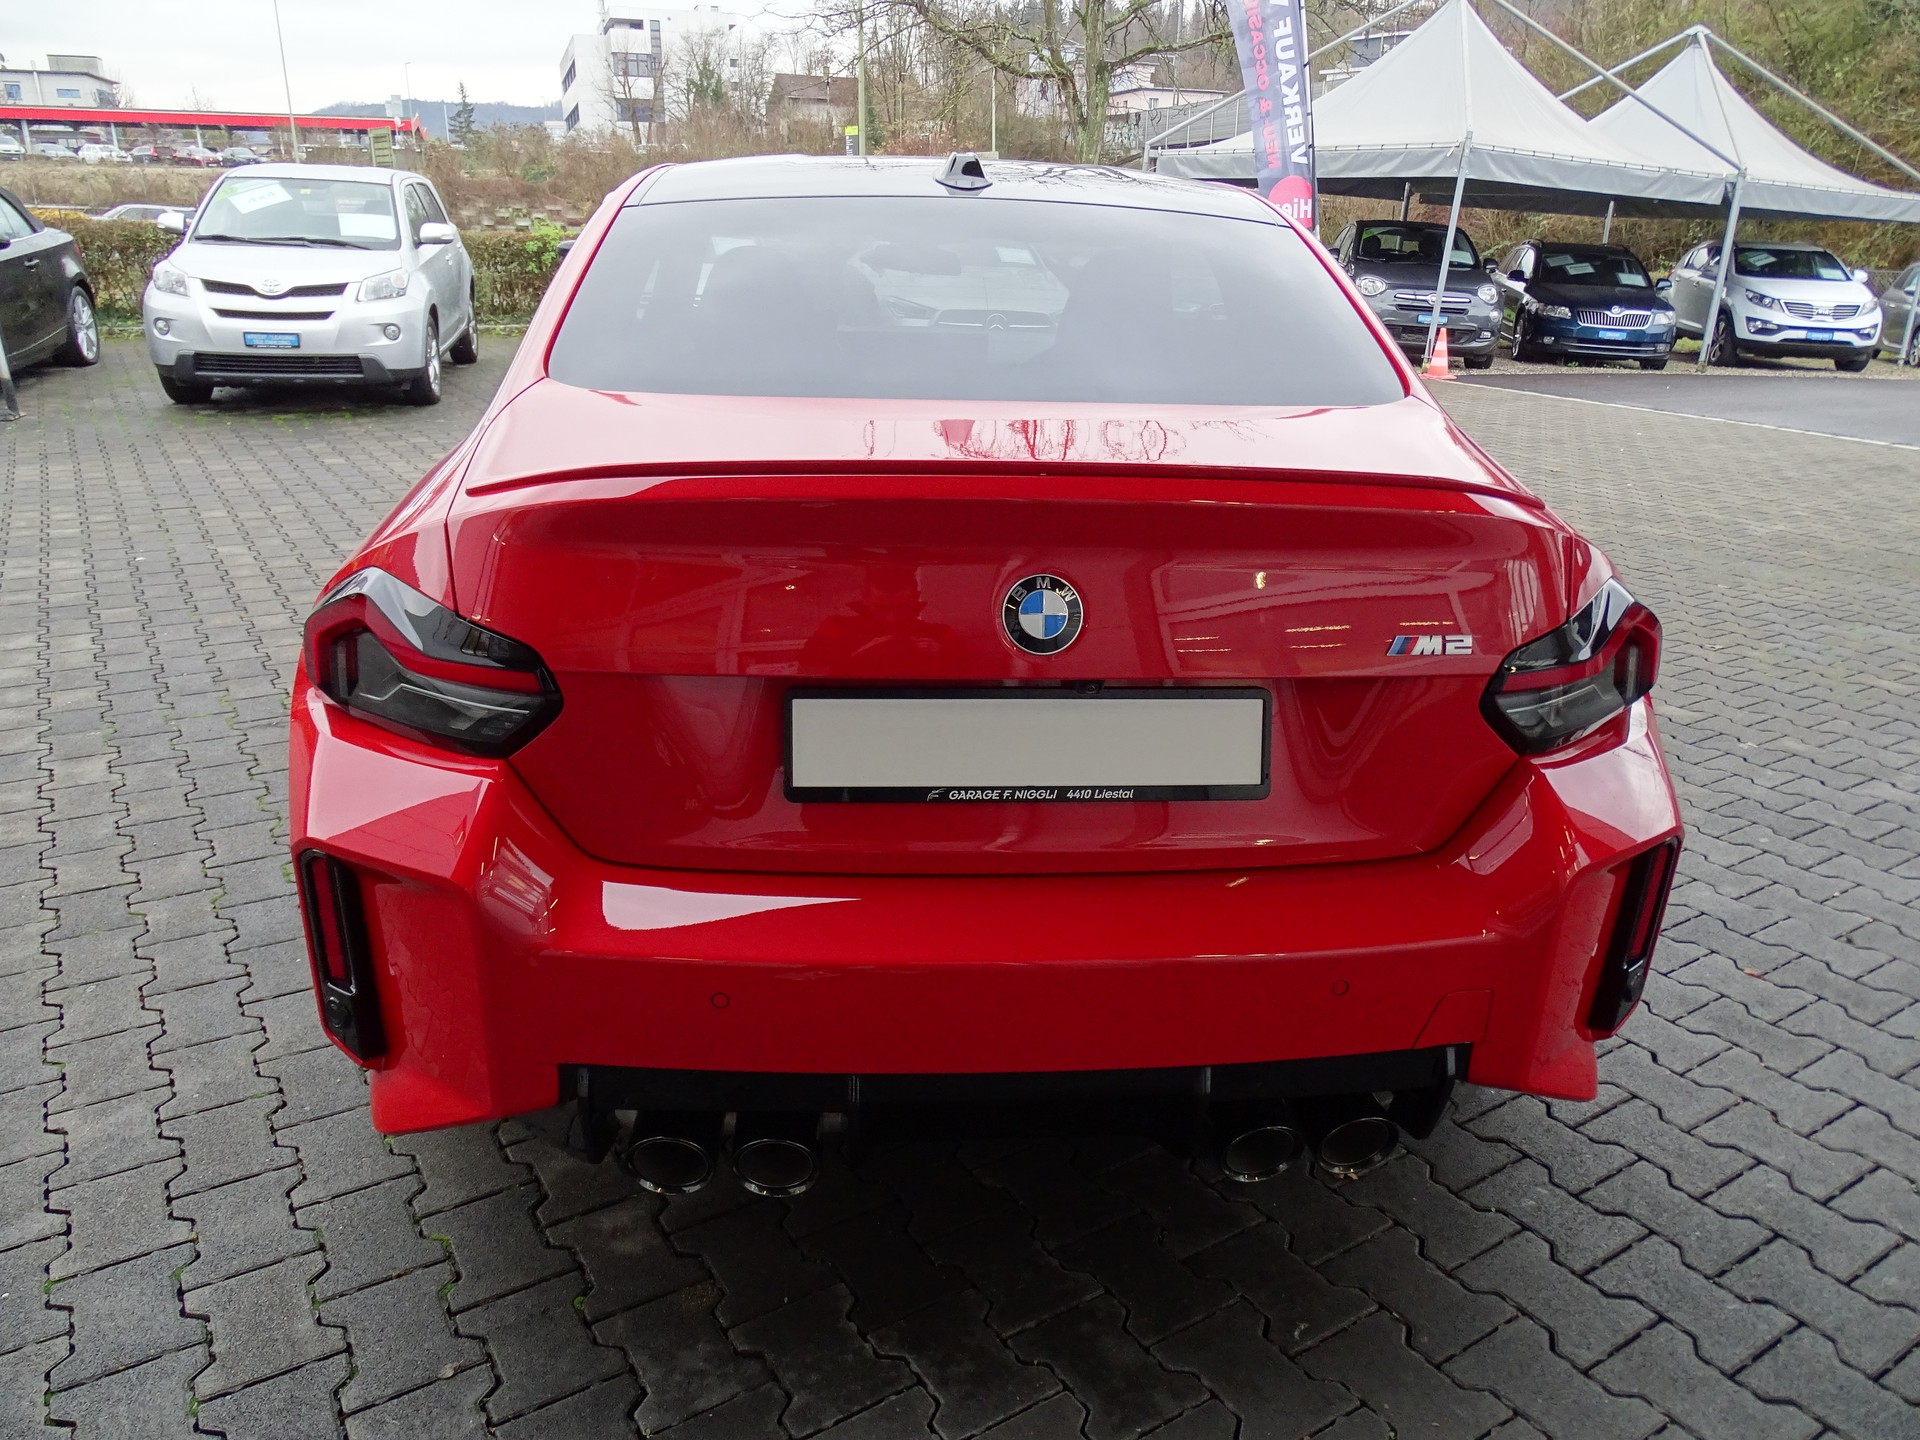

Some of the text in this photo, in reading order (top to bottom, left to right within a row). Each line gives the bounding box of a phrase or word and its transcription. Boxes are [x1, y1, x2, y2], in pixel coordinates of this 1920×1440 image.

[1011, 576, 1076, 602] BMW
[1409, 635, 1473, 656] M2
[949, 789, 1134, 800] GARAGE F. NIGGLI 4410 Liestal
